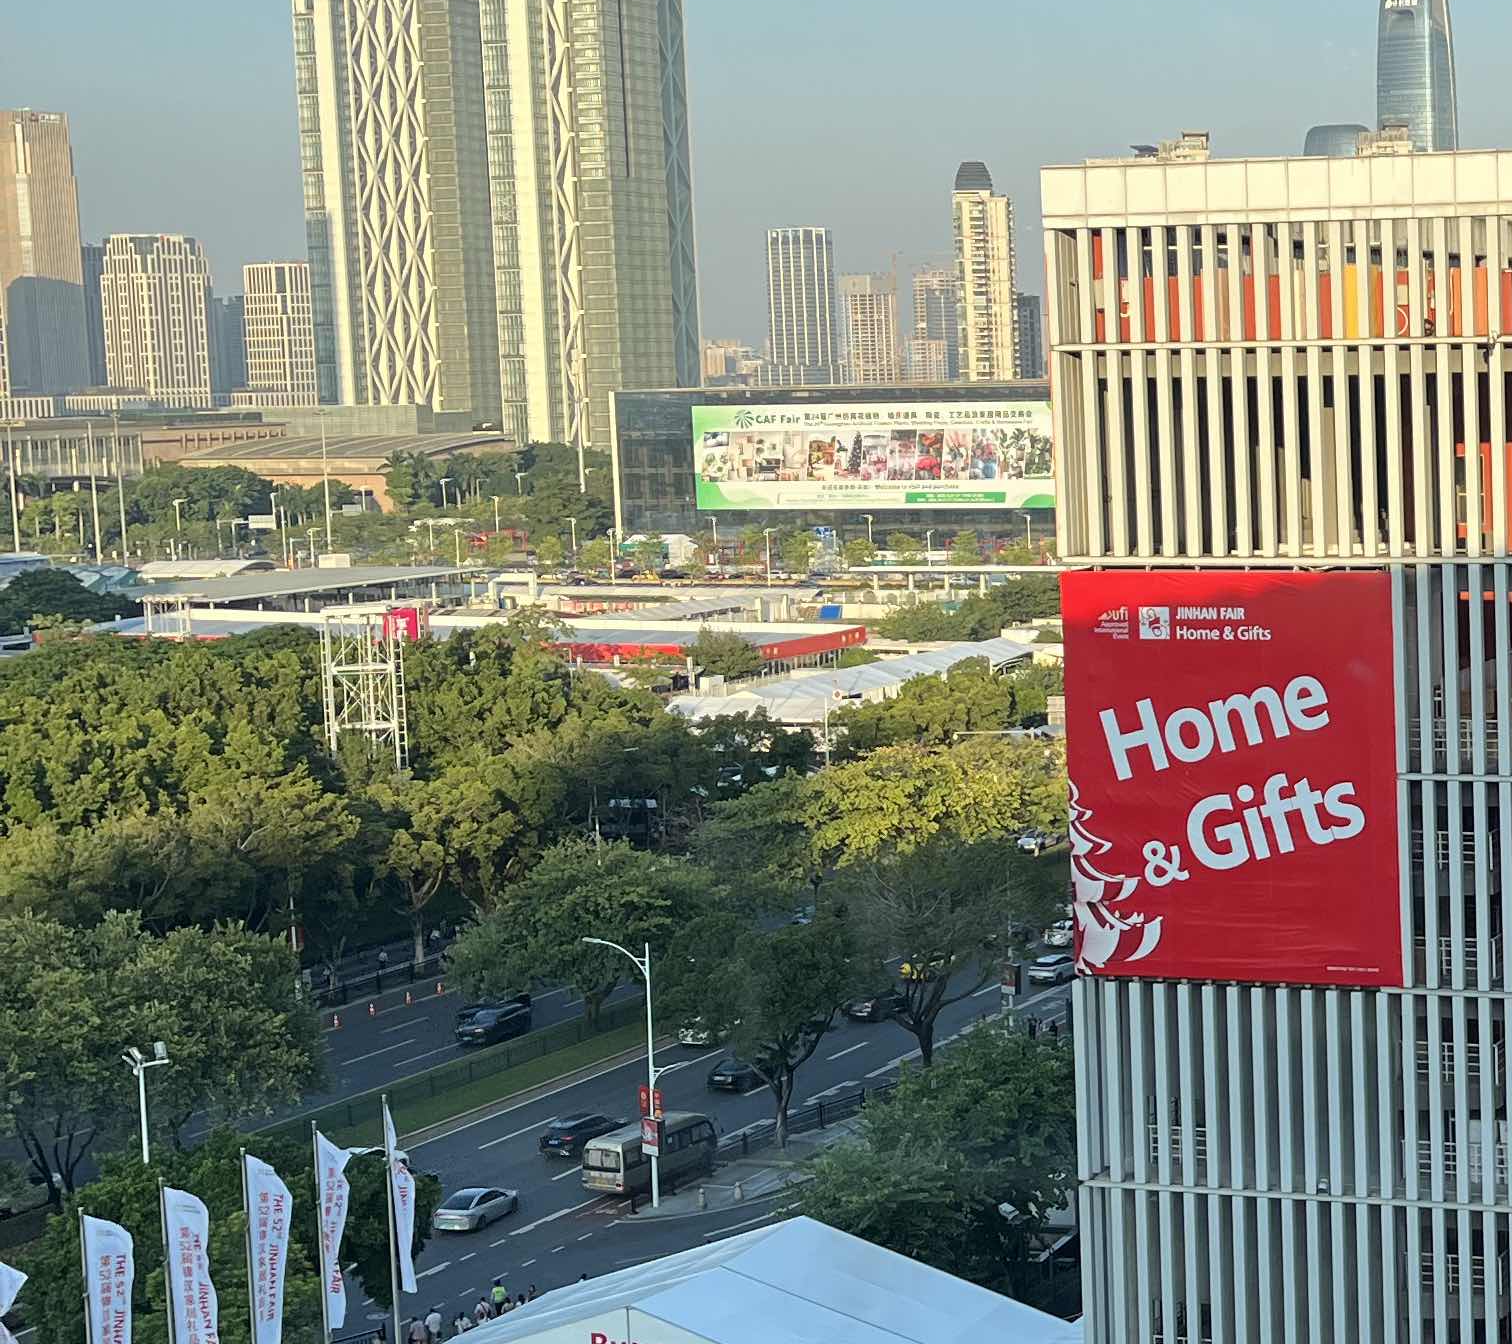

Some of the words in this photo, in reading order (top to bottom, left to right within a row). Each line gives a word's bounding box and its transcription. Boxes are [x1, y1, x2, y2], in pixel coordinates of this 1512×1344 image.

[756, 414, 776, 425] CAF
[780, 414, 800, 424] Fair
[1175, 607, 1217, 620] JINHAN
[1220, 607, 1245, 620] FAIR
[1176, 626, 1219, 640] Home
[1223, 626, 1234, 640] &
[1237, 626, 1272, 641] Gifts
[1099, 675, 1330, 782] Home
[1142, 840, 1191, 887] &
[1186, 772, 1366, 872] Gifts
[116, 1254, 127, 1278] THE
[198, 1281, 213, 1330] JINHAN
